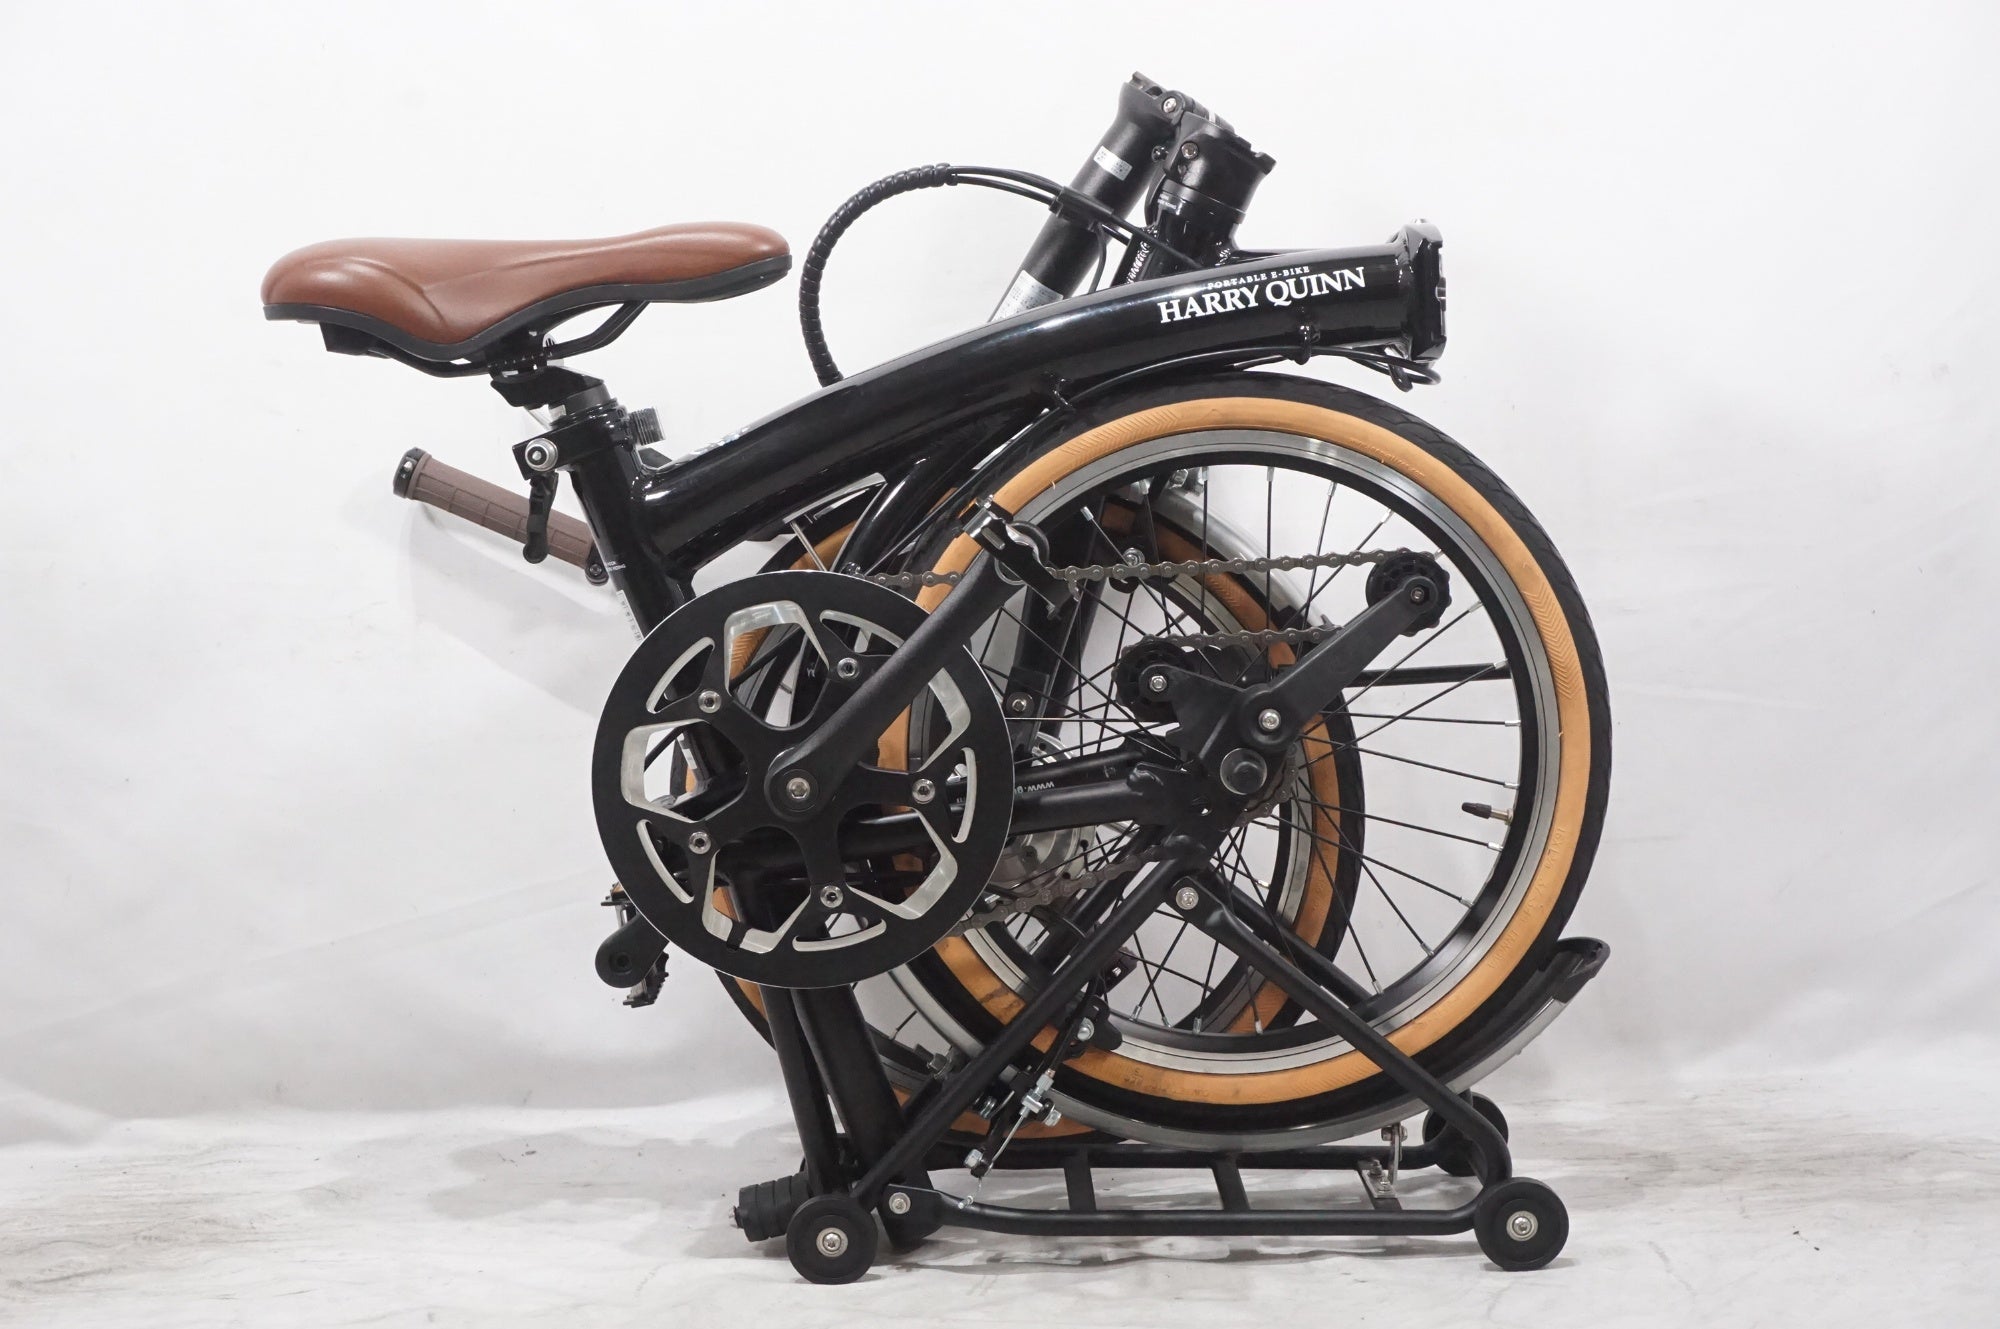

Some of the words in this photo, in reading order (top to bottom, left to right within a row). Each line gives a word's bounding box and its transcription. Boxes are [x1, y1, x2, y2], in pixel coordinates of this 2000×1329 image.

[1157, 285, 1259, 323] HARRY
[1265, 267, 1365, 306] QUINN
[1208, 273, 1267, 290] PORTABLE
[1271, 266, 1310, 279] E-BIKE
